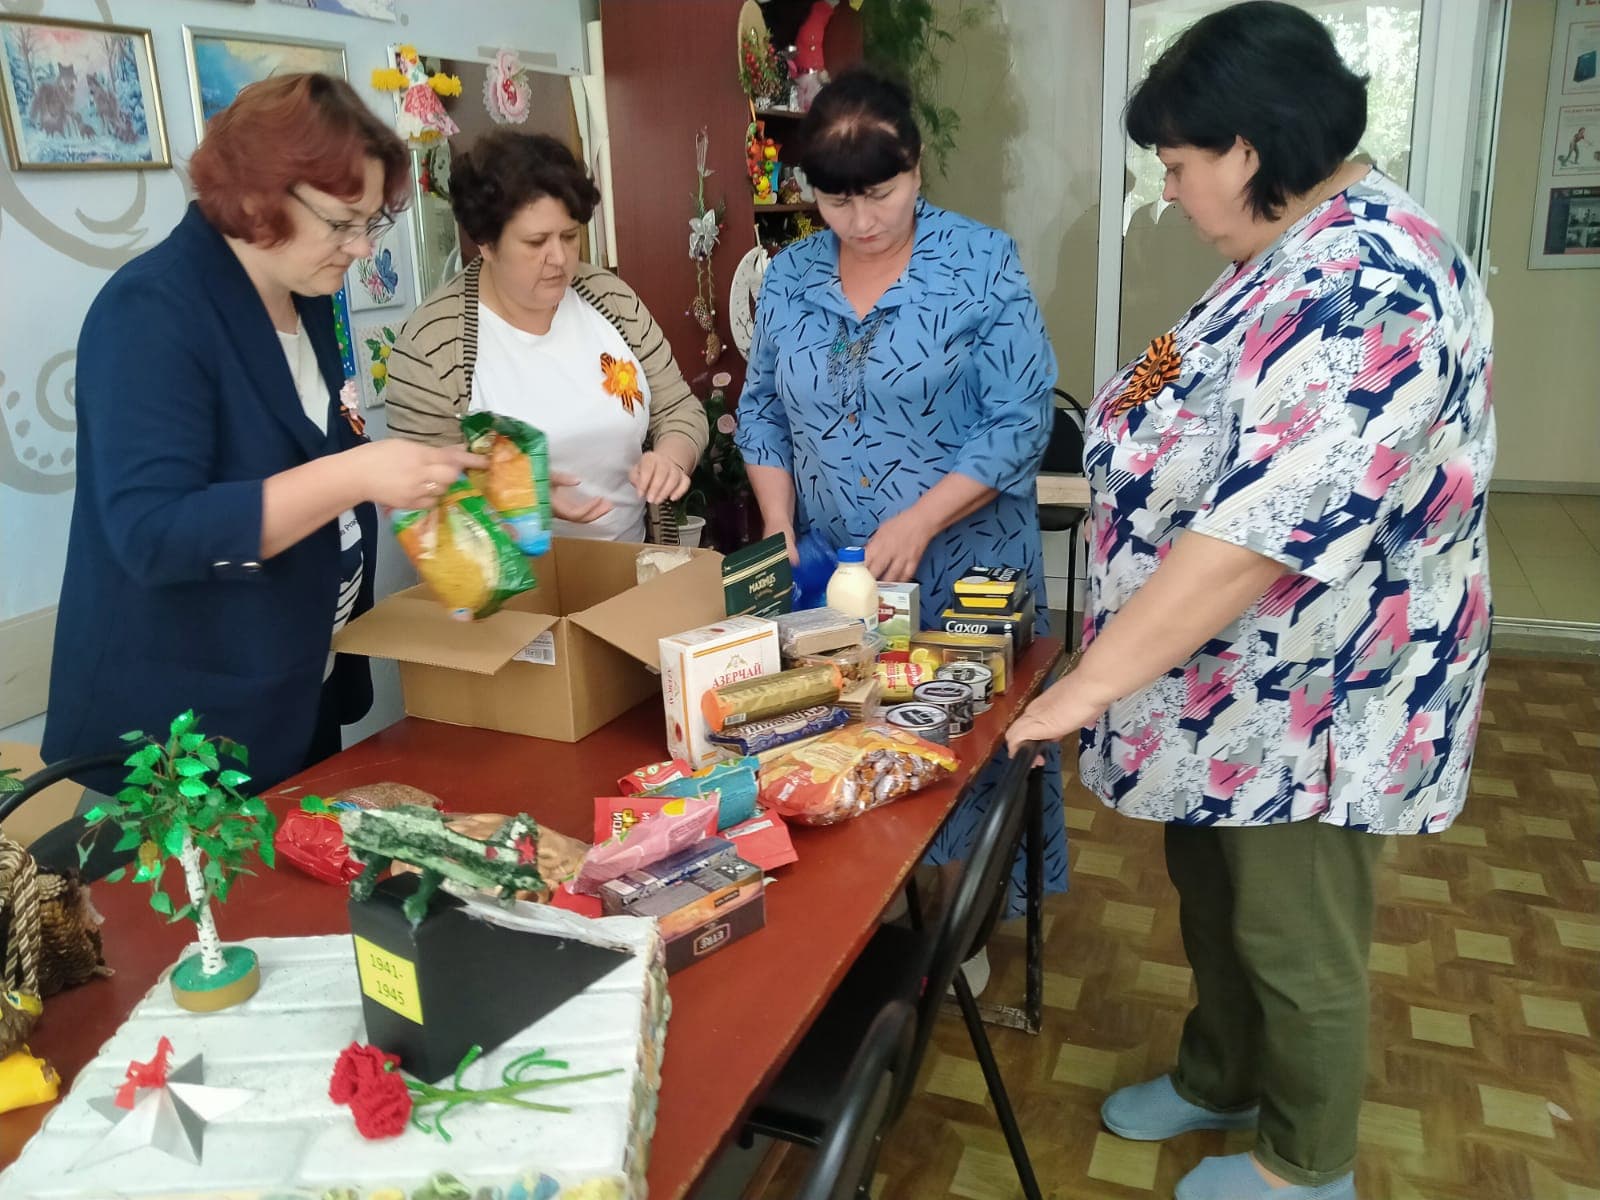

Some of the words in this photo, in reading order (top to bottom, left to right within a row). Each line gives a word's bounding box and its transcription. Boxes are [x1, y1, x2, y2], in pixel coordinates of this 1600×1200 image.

[945, 620, 988, 634] Сахар
[712, 662, 763, 689] АЗЕРЧАЙ
[370, 953, 404, 980] 1941-
[376, 980, 405, 1006] 1945
